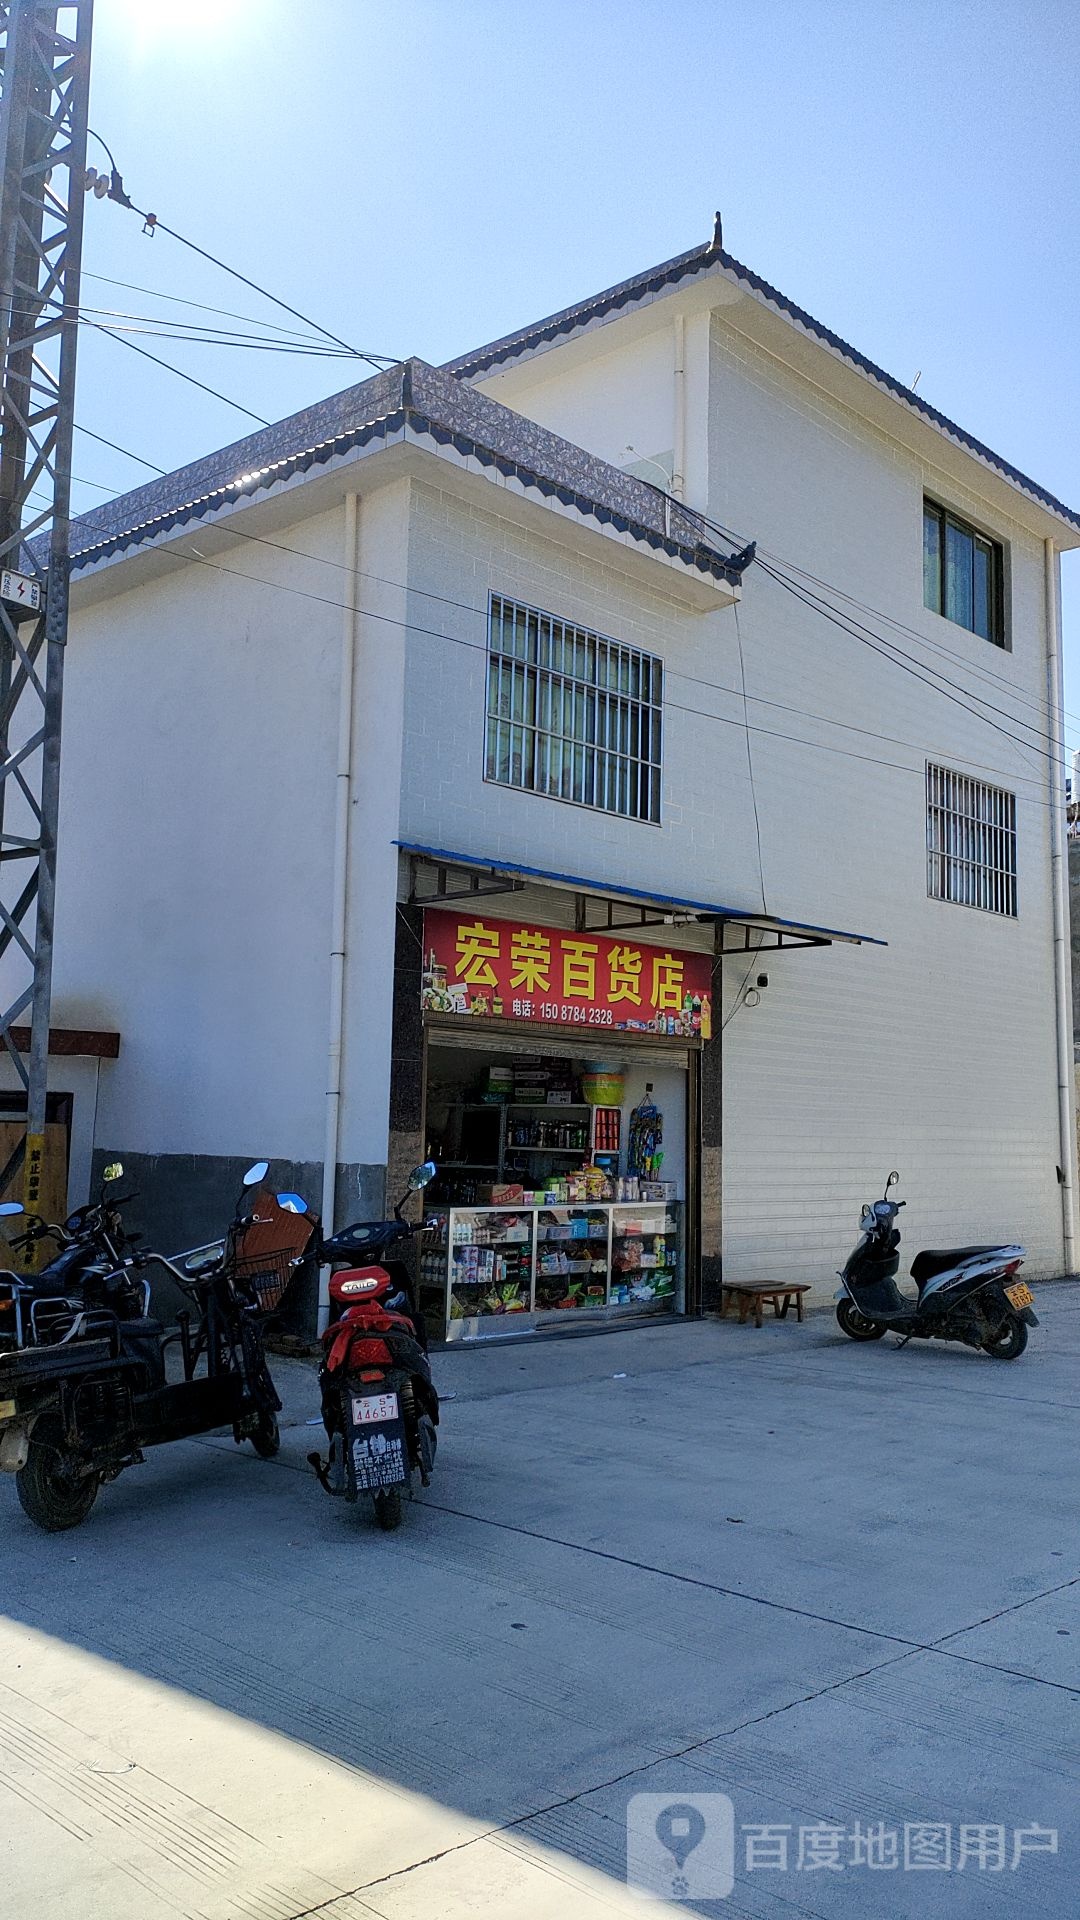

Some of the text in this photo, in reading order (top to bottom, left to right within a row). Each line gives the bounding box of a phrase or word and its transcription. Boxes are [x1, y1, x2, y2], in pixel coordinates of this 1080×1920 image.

[455, 922, 684, 1011] 宏荣百货店
[540, 1002, 558, 1019] 150
[561, 1005, 586, 1022] 8784
[588, 1007, 613, 1025] 2328
[356, 1405, 395, 1420] 44657
